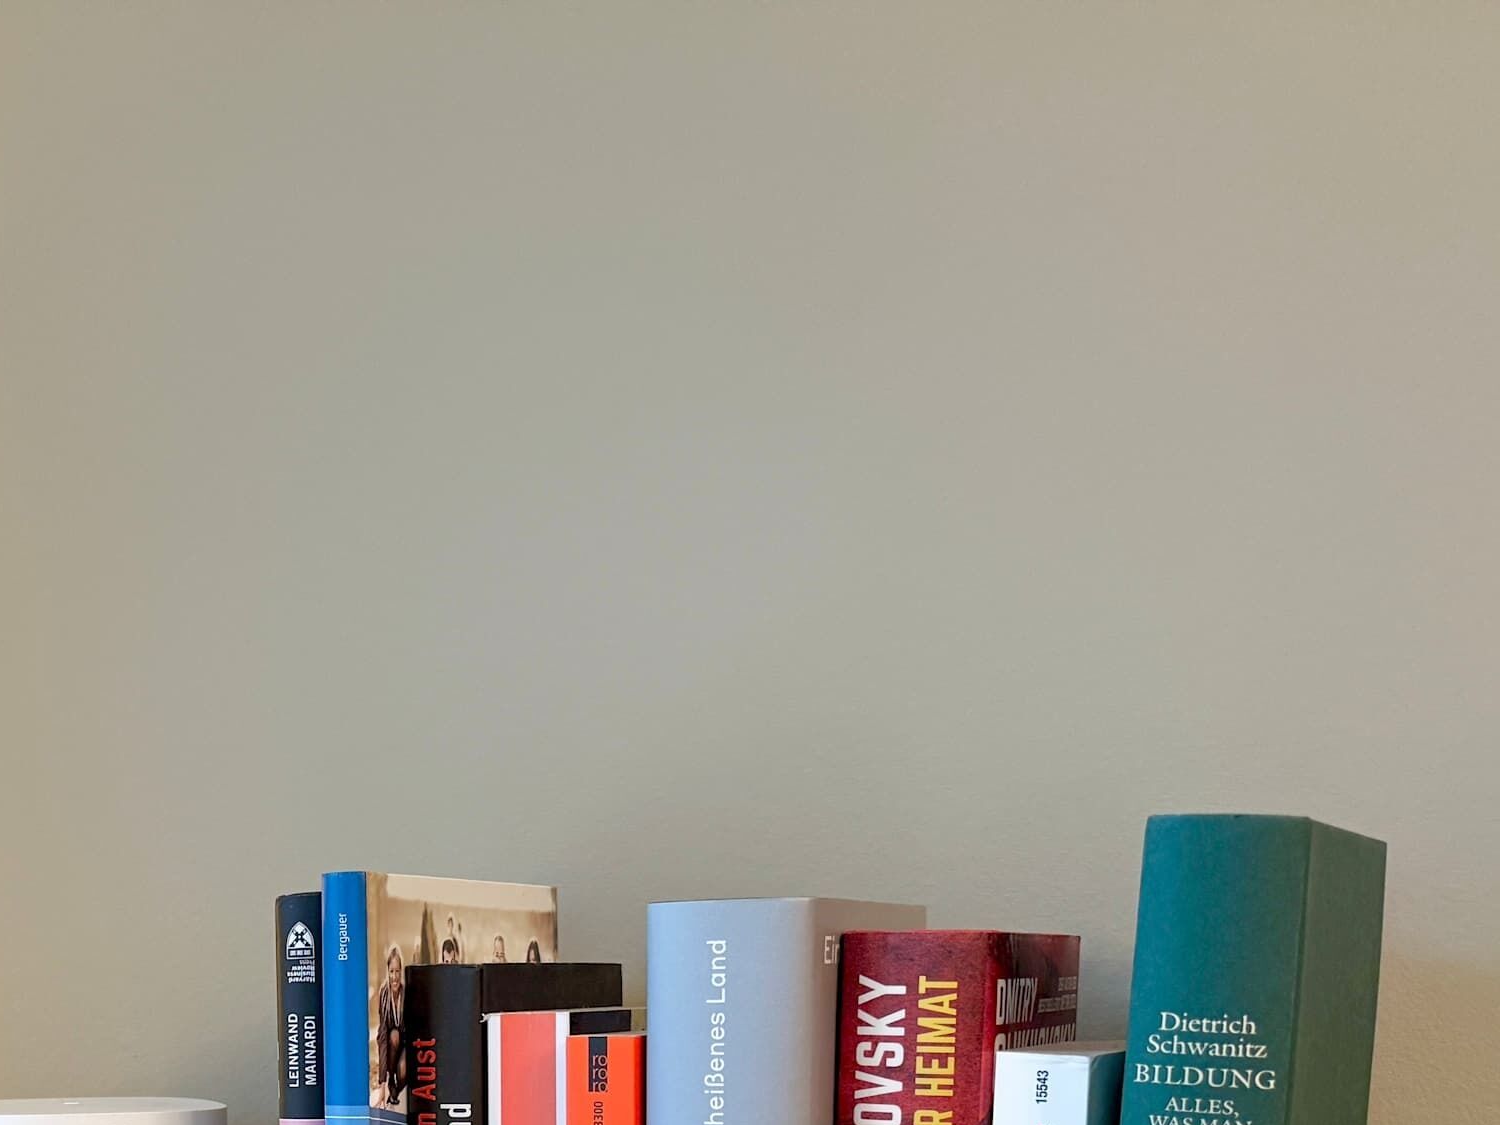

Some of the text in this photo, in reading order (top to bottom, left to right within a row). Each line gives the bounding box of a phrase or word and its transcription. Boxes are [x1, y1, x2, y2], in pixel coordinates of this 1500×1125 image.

[337, 913, 348, 961] Bergauer
[706, 939, 727, 1004] Land
[914, 975, 958, 1097] HEIMAT
[1146, 1034, 1268, 1058] Schwanitz
[1158, 1011, 1257, 1035] Dietrich
[288, 1013, 300, 1089] LEINWAND
[304, 1014, 317, 1087] MAINARDI
[412, 1038, 437, 1102] Aust
[1035, 1069, 1049, 1105] 15543
[1133, 1063, 1277, 1090] BILDUNG
[1164, 1096, 1240, 1118] ALLES,
